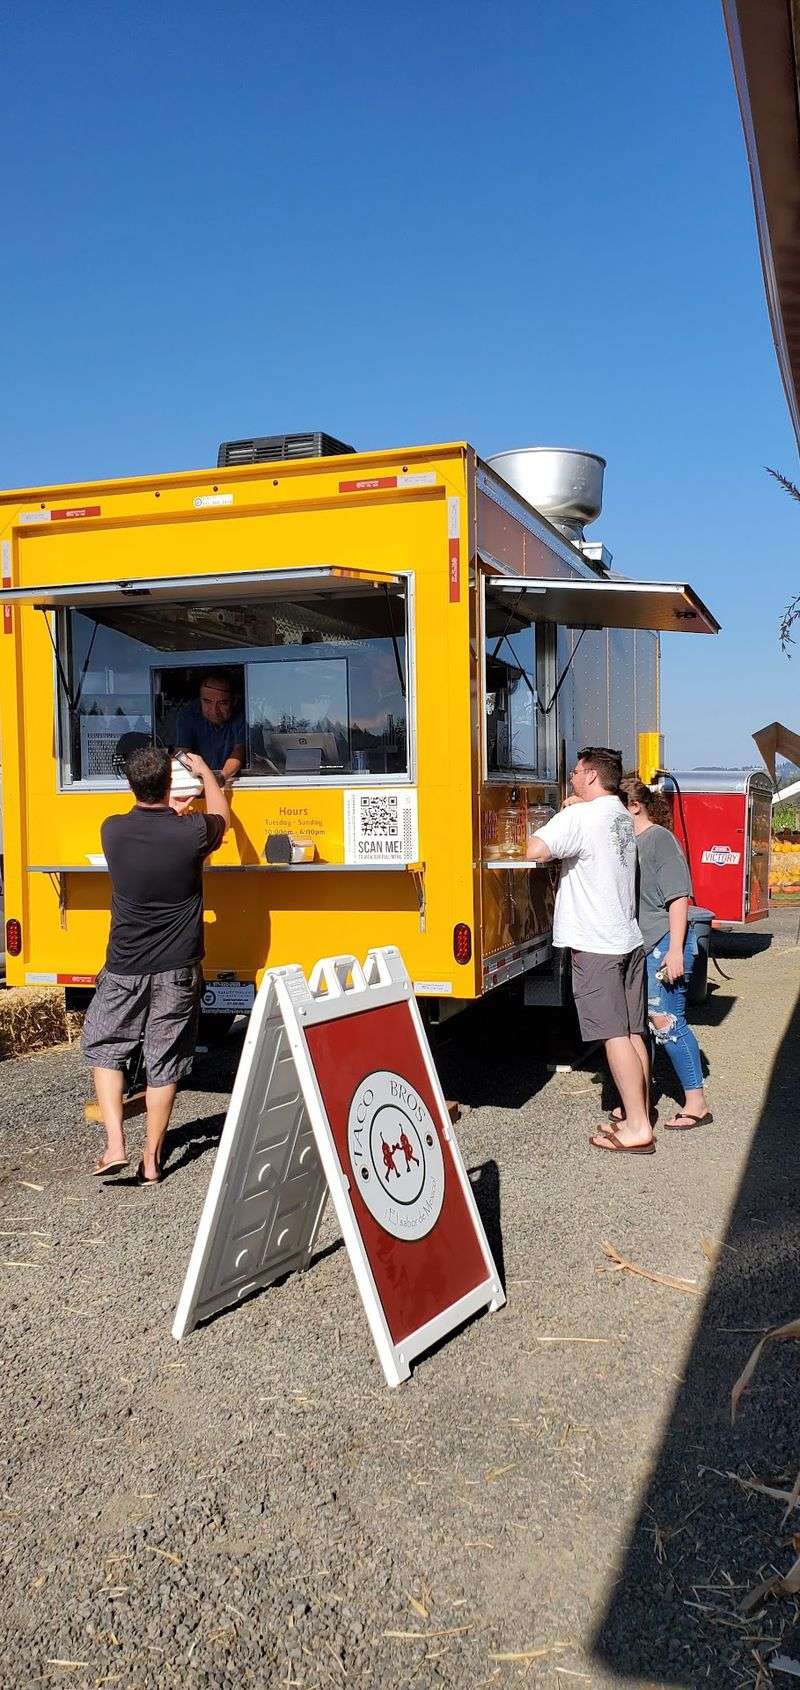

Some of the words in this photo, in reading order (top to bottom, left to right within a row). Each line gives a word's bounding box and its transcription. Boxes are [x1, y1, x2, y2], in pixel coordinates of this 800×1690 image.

[279, 806, 308, 816] Hours
[358, 840, 383, 854] SCAN
[385, 840, 403, 853] ME!
[704, 852, 738, 863] VICTORY
[390, 1080, 425, 1122] BROS
